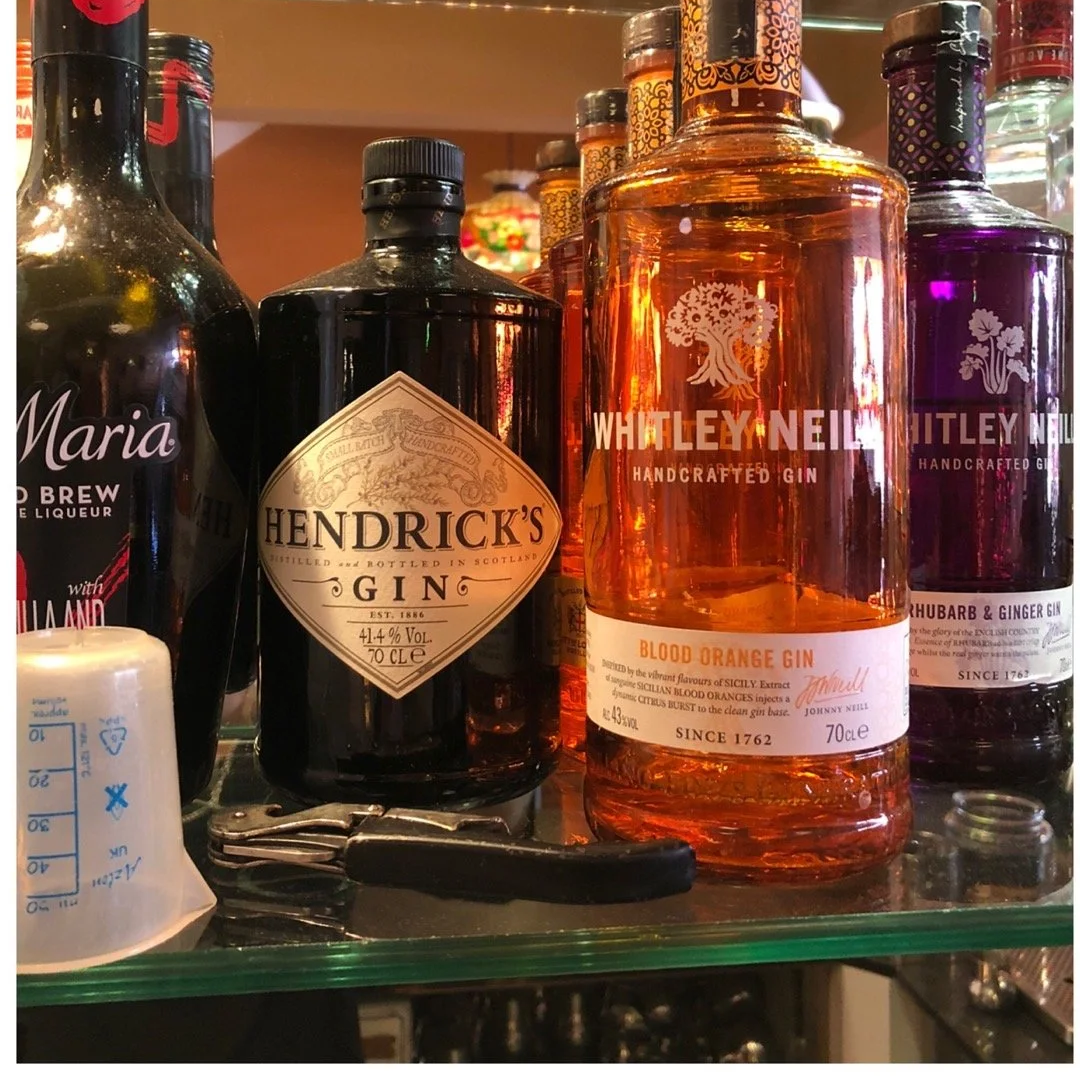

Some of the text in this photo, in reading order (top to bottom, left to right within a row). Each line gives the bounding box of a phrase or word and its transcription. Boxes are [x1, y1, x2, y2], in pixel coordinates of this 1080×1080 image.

[17, 389, 174, 471] Maria
[593, 410, 750, 451] WHITLEY
[407, 435, 477, 465] HANDCRAFTED
[919, 457, 1029, 471] HANDCRAFTED
[633, 466, 770, 484] HANDCRAFTED
[783, 467, 817, 484] GIN
[40, 484, 120, 505] BREW
[35, 507, 112, 519] LIQUEUR
[265, 505, 544, 551] HENDRICK'S
[270, 554, 331, 567] DISTILLED
[367, 560, 440, 568] BOTTLED
[450, 559, 466, 567] IN
[475, 553, 538, 567] SCOTLAND
[67, 574, 104, 596] with
[353, 575, 449, 602] GIN
[400, 611, 425, 619] 1886
[909, 601, 1061, 620] RHUBARB & GINGER GIN
[359, 627, 385, 645] 41.4
[388, 626, 401, 645] %
[367, 648, 385, 665] 70
[639, 639, 815, 668] BLOOD ORANGE GIN
[636, 668, 646, 678] the
[648, 670, 676, 682] vibrant
[677, 673, 712, 686] flavours
[714, 677, 724, 687] of
[760, 680, 790, 689] Extract
[958, 670, 1029, 680] SINCE 1762
[637, 682, 672, 695] SICILIAN
[673, 688, 705, 699] BLOOD
[707, 690, 753, 702] ORANGES
[755, 693, 783, 704] injects
[637, 694, 666, 708] CITRUS
[668, 700, 696, 711] BURST
[698, 705, 706, 713] to
[708, 705, 723, 714] the
[724, 706, 748, 716] clean
[750, 708, 765, 718] gin
[804, 703, 869, 716] JOHNNY NEILL
[29, 727, 45, 742] 10
[676, 727, 773, 746] SINCE 1762
[29, 775, 49, 788] 20
[27, 819, 49, 832] 30
[110, 845, 128, 859] UK
[27, 862, 49, 875] 40
